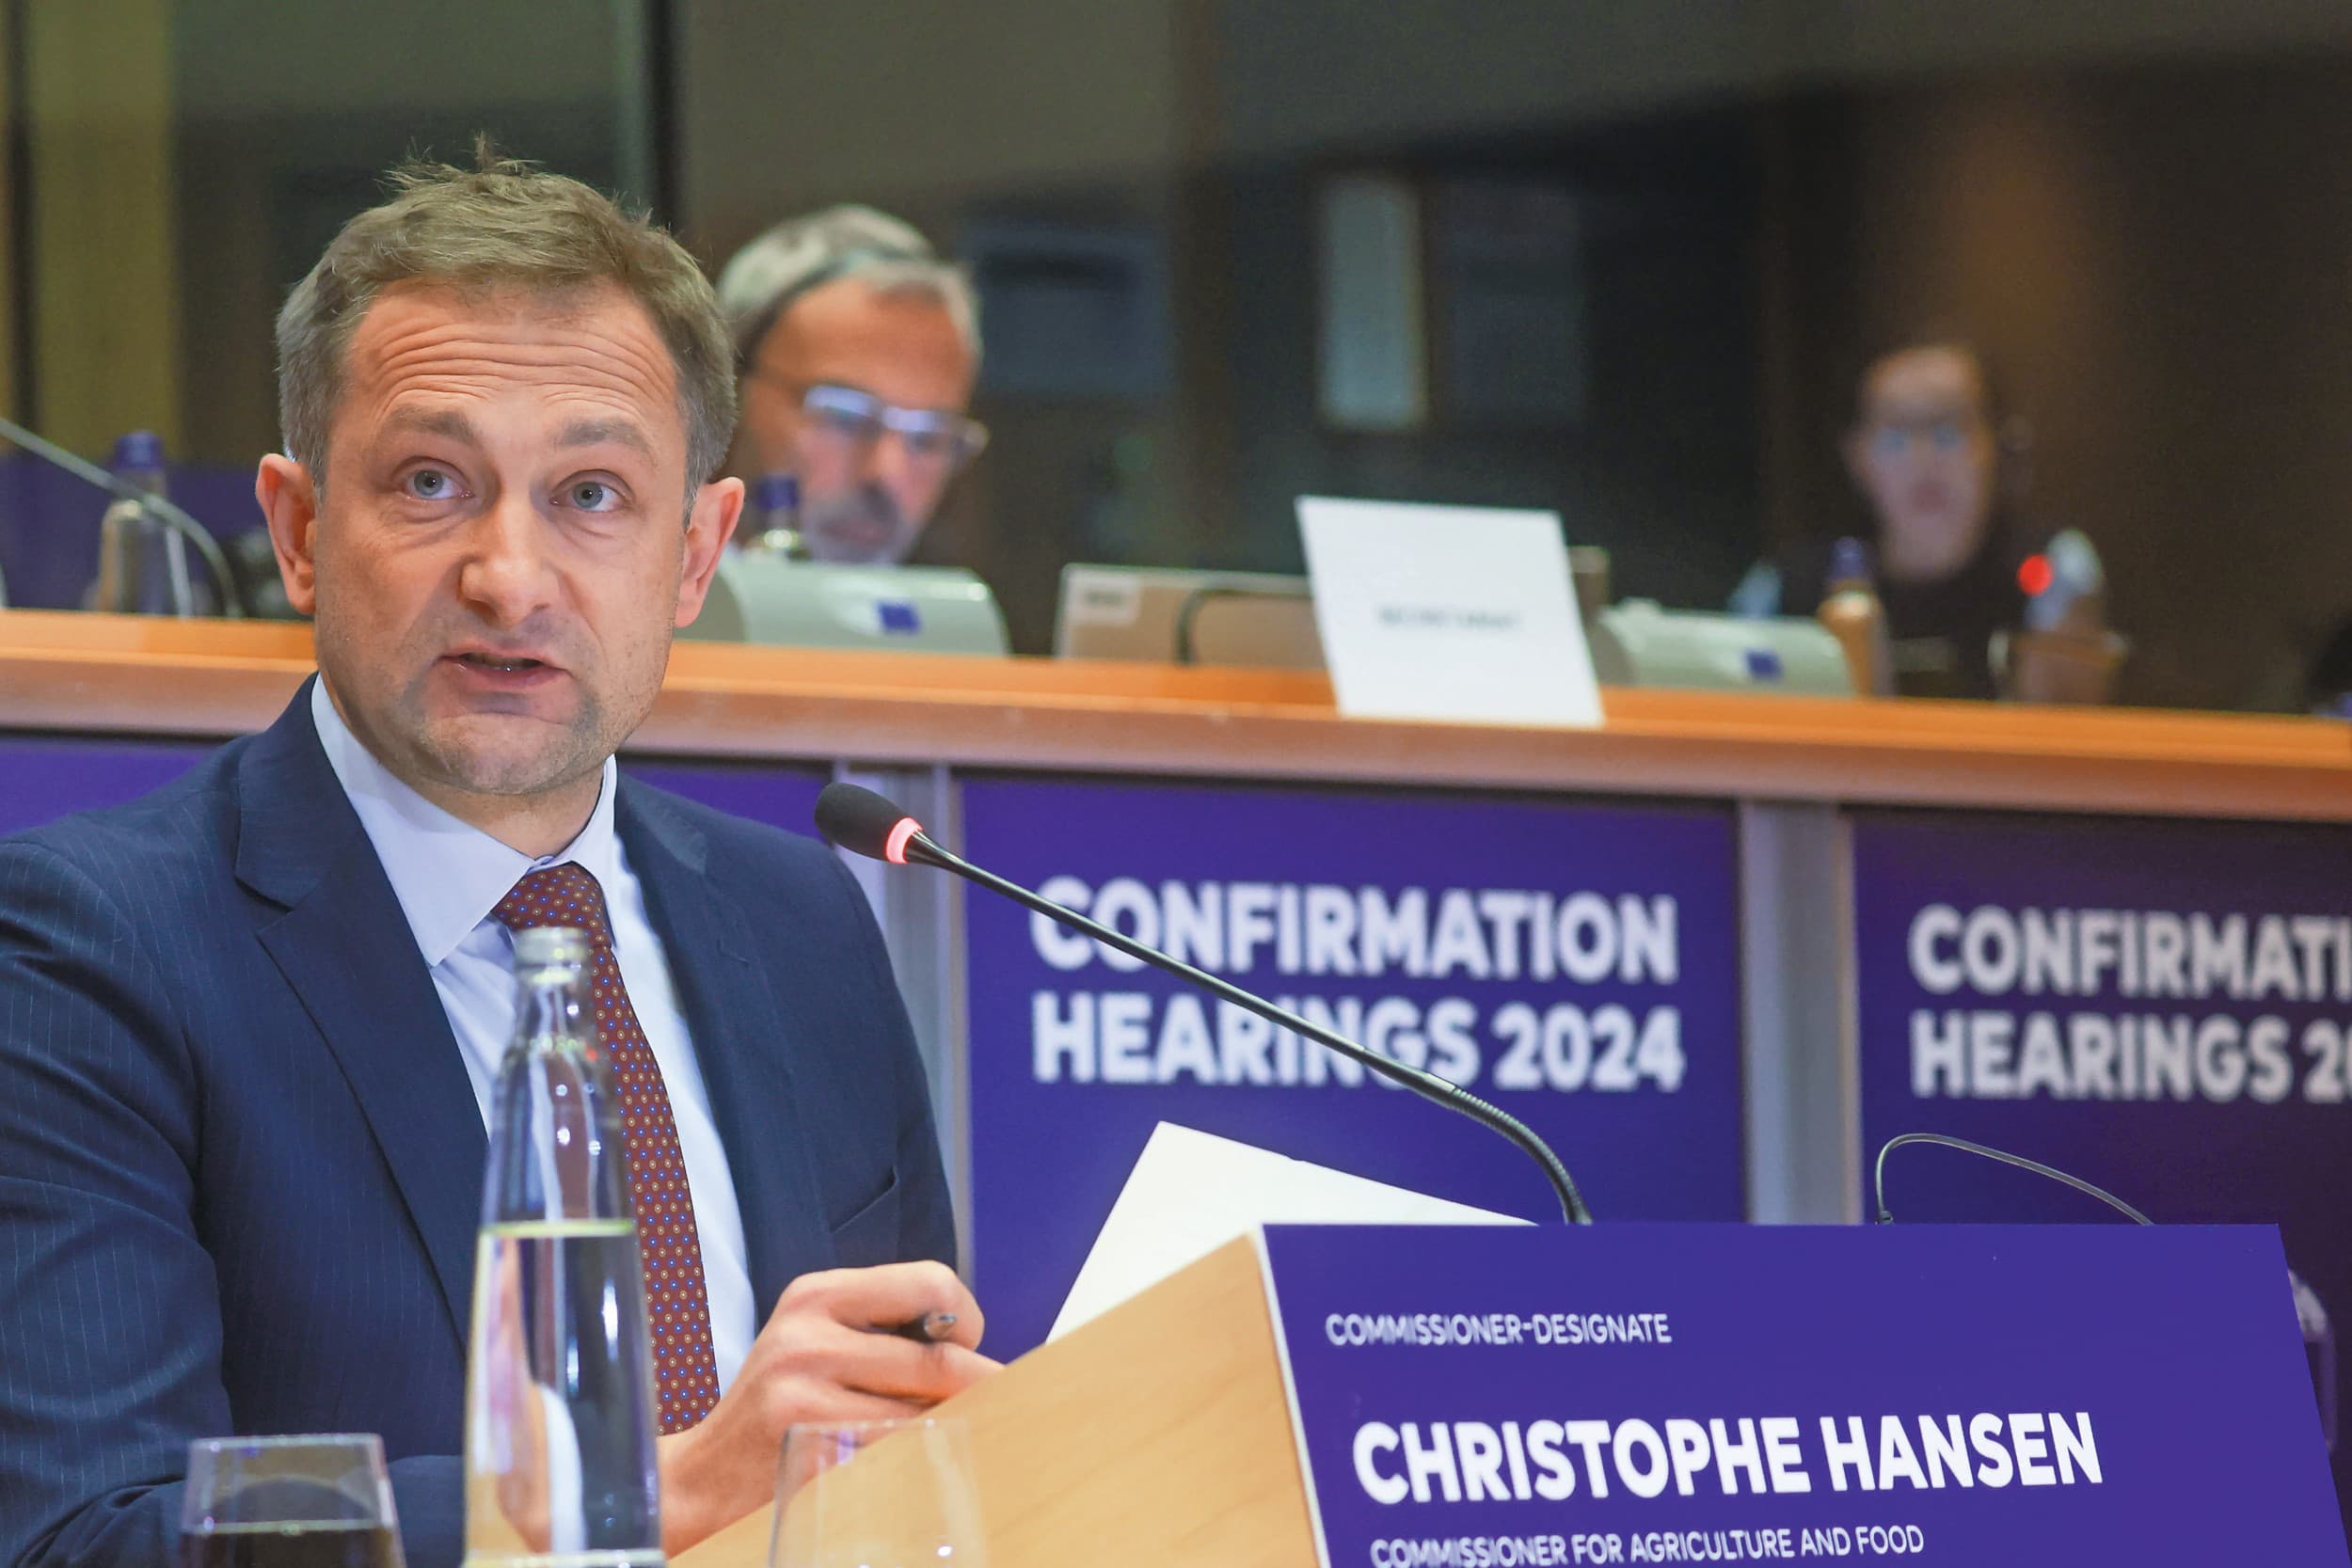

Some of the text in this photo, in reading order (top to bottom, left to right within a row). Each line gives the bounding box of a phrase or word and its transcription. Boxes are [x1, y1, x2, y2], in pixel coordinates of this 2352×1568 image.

[1030, 876, 1677, 984] CONFIRMATION
[1907, 903, 2352, 1001] CONFIRMATI
[1031, 992, 1686, 1093] HEARINGS 2024
[1909, 1009, 2352, 1103] HEARINGS 2
[1326, 1313, 1673, 1346] COMMISSIONER-DESIGNATE
[1353, 1412, 2104, 1504] CHRISTOPHE HANSEN
[1370, 1525, 1924, 1568] COMMISSIONER FOR AGRICULTURE AND FOOD
